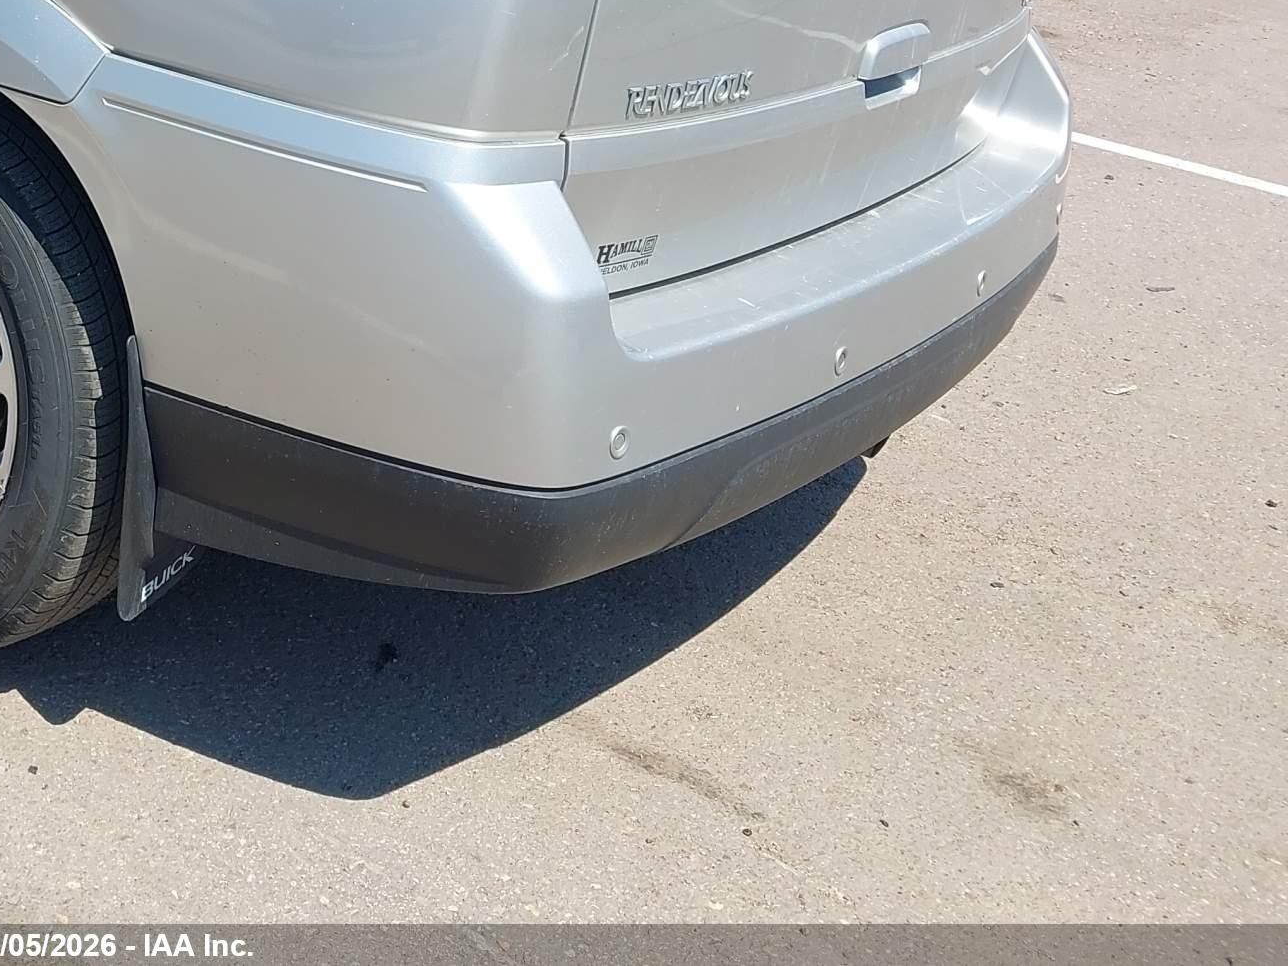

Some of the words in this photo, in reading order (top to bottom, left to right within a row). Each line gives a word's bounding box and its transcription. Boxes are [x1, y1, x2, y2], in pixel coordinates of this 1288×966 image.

[625, 69, 754, 120] RENDEZVOUS
[596, 238, 644, 265] HAMILL
[630, 258, 649, 269] IOWA
[140, 544, 196, 603] BUICK
